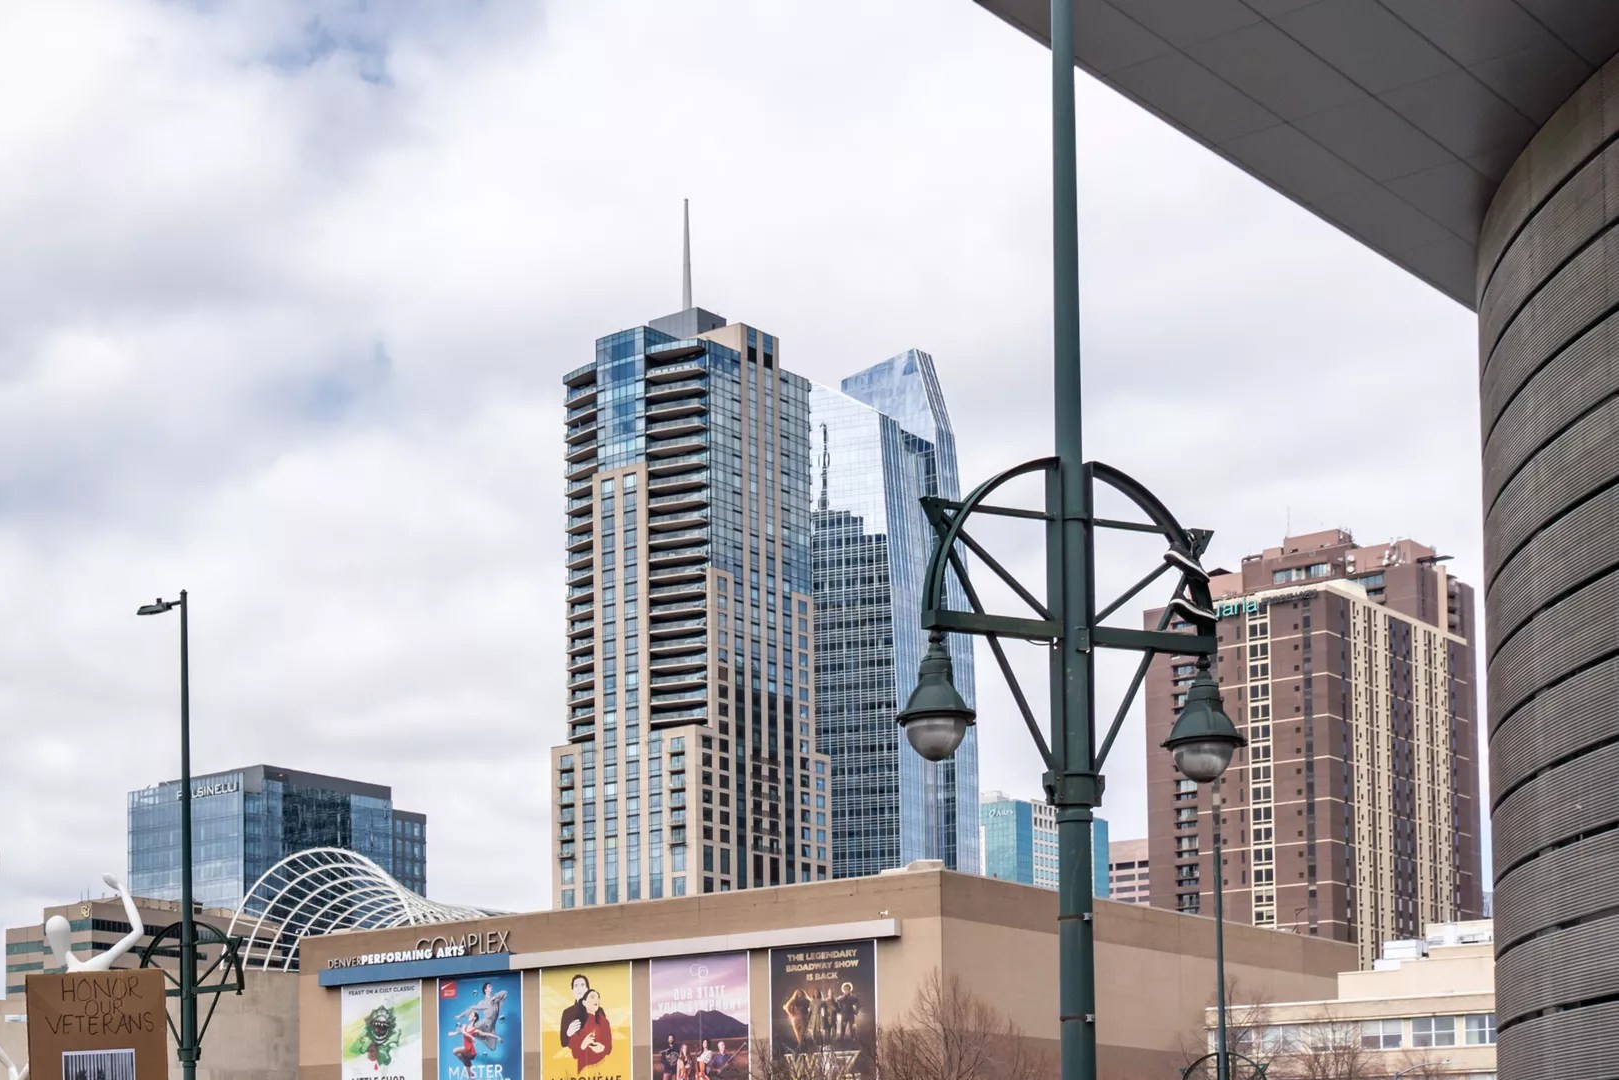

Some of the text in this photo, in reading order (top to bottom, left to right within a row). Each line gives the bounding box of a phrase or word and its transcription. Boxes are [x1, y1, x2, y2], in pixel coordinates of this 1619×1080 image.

[176, 782, 238, 800] PLSINELLI
[415, 931, 509, 956] COMPLEX
[327, 945, 465, 969] DENVER PERFORMING ARTS
[786, 949, 858, 962] THE LEGENDARY
[785, 959, 859, 973] BROADWAY SHOW
[806, 971, 838, 981] IS BACK
[61, 976, 143, 1002] HONOR
[393, 985, 415, 993] CLASSIC
[84, 998, 125, 1017] OUR
[45, 1011, 155, 1036] VETERANS
[448, 1063, 503, 1080] MASTER
